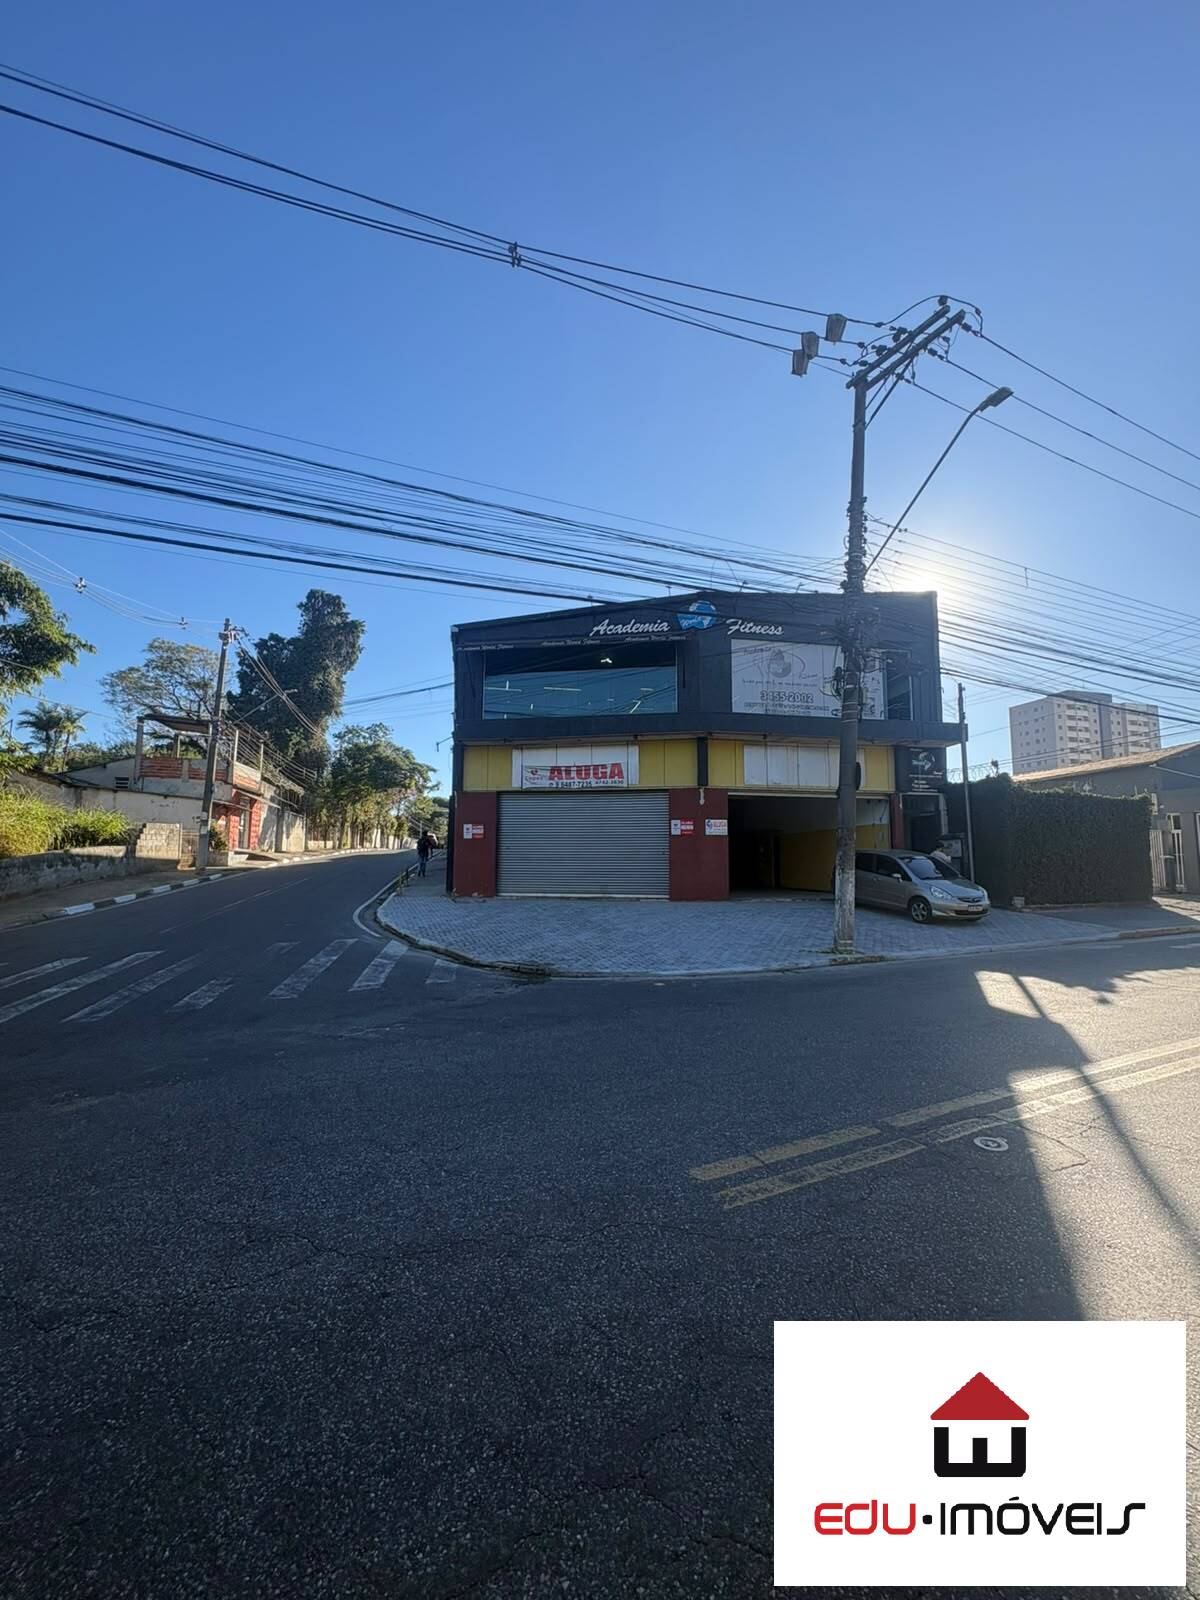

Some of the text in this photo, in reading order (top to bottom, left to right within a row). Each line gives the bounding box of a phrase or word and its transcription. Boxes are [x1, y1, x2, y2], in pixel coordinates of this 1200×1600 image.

[589, 617, 671, 637] Academia
[725, 618, 784, 636] Fitness
[549, 763, 624, 781] ALUGA
